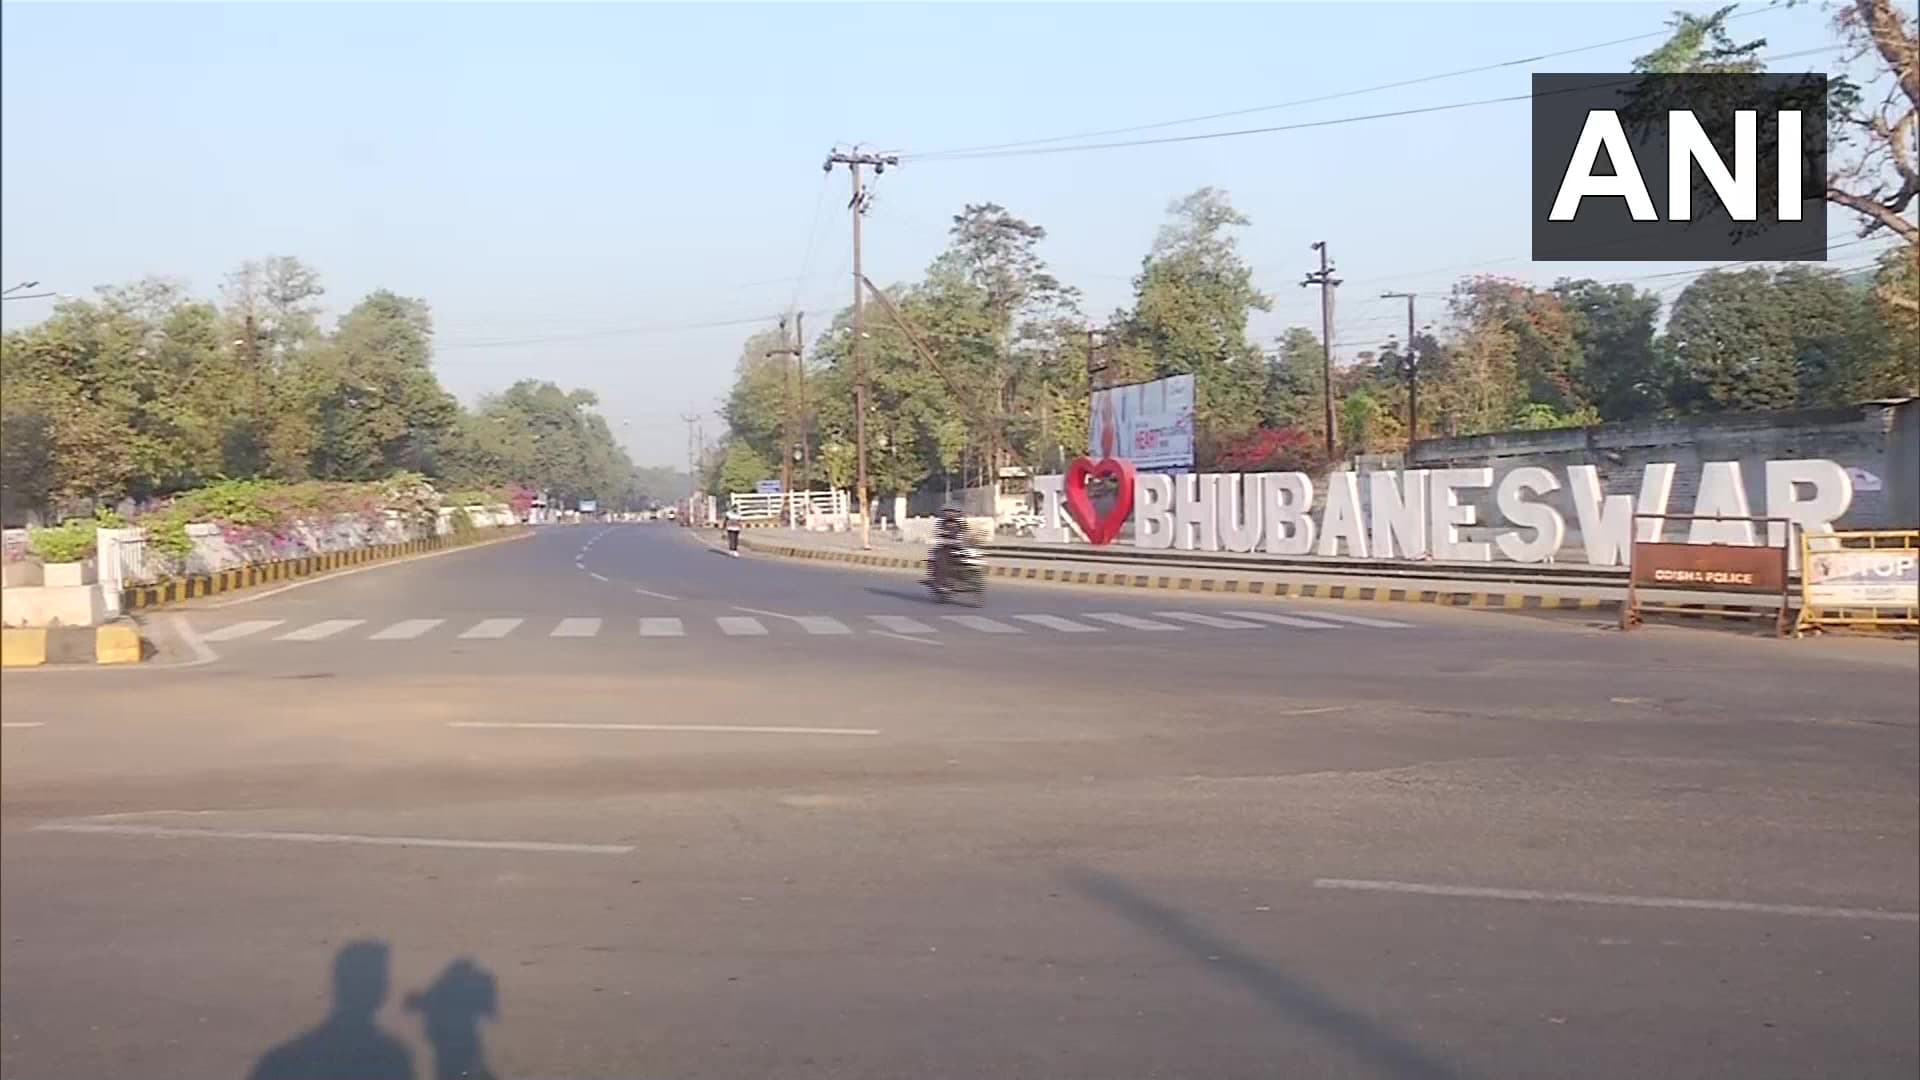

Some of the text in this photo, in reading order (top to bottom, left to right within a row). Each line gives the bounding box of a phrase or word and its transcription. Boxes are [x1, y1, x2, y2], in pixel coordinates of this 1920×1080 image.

[1034, 459, 1853, 569] I BHUBANESWAR
[1655, 569, 1753, 585] ODISHA POLICE
